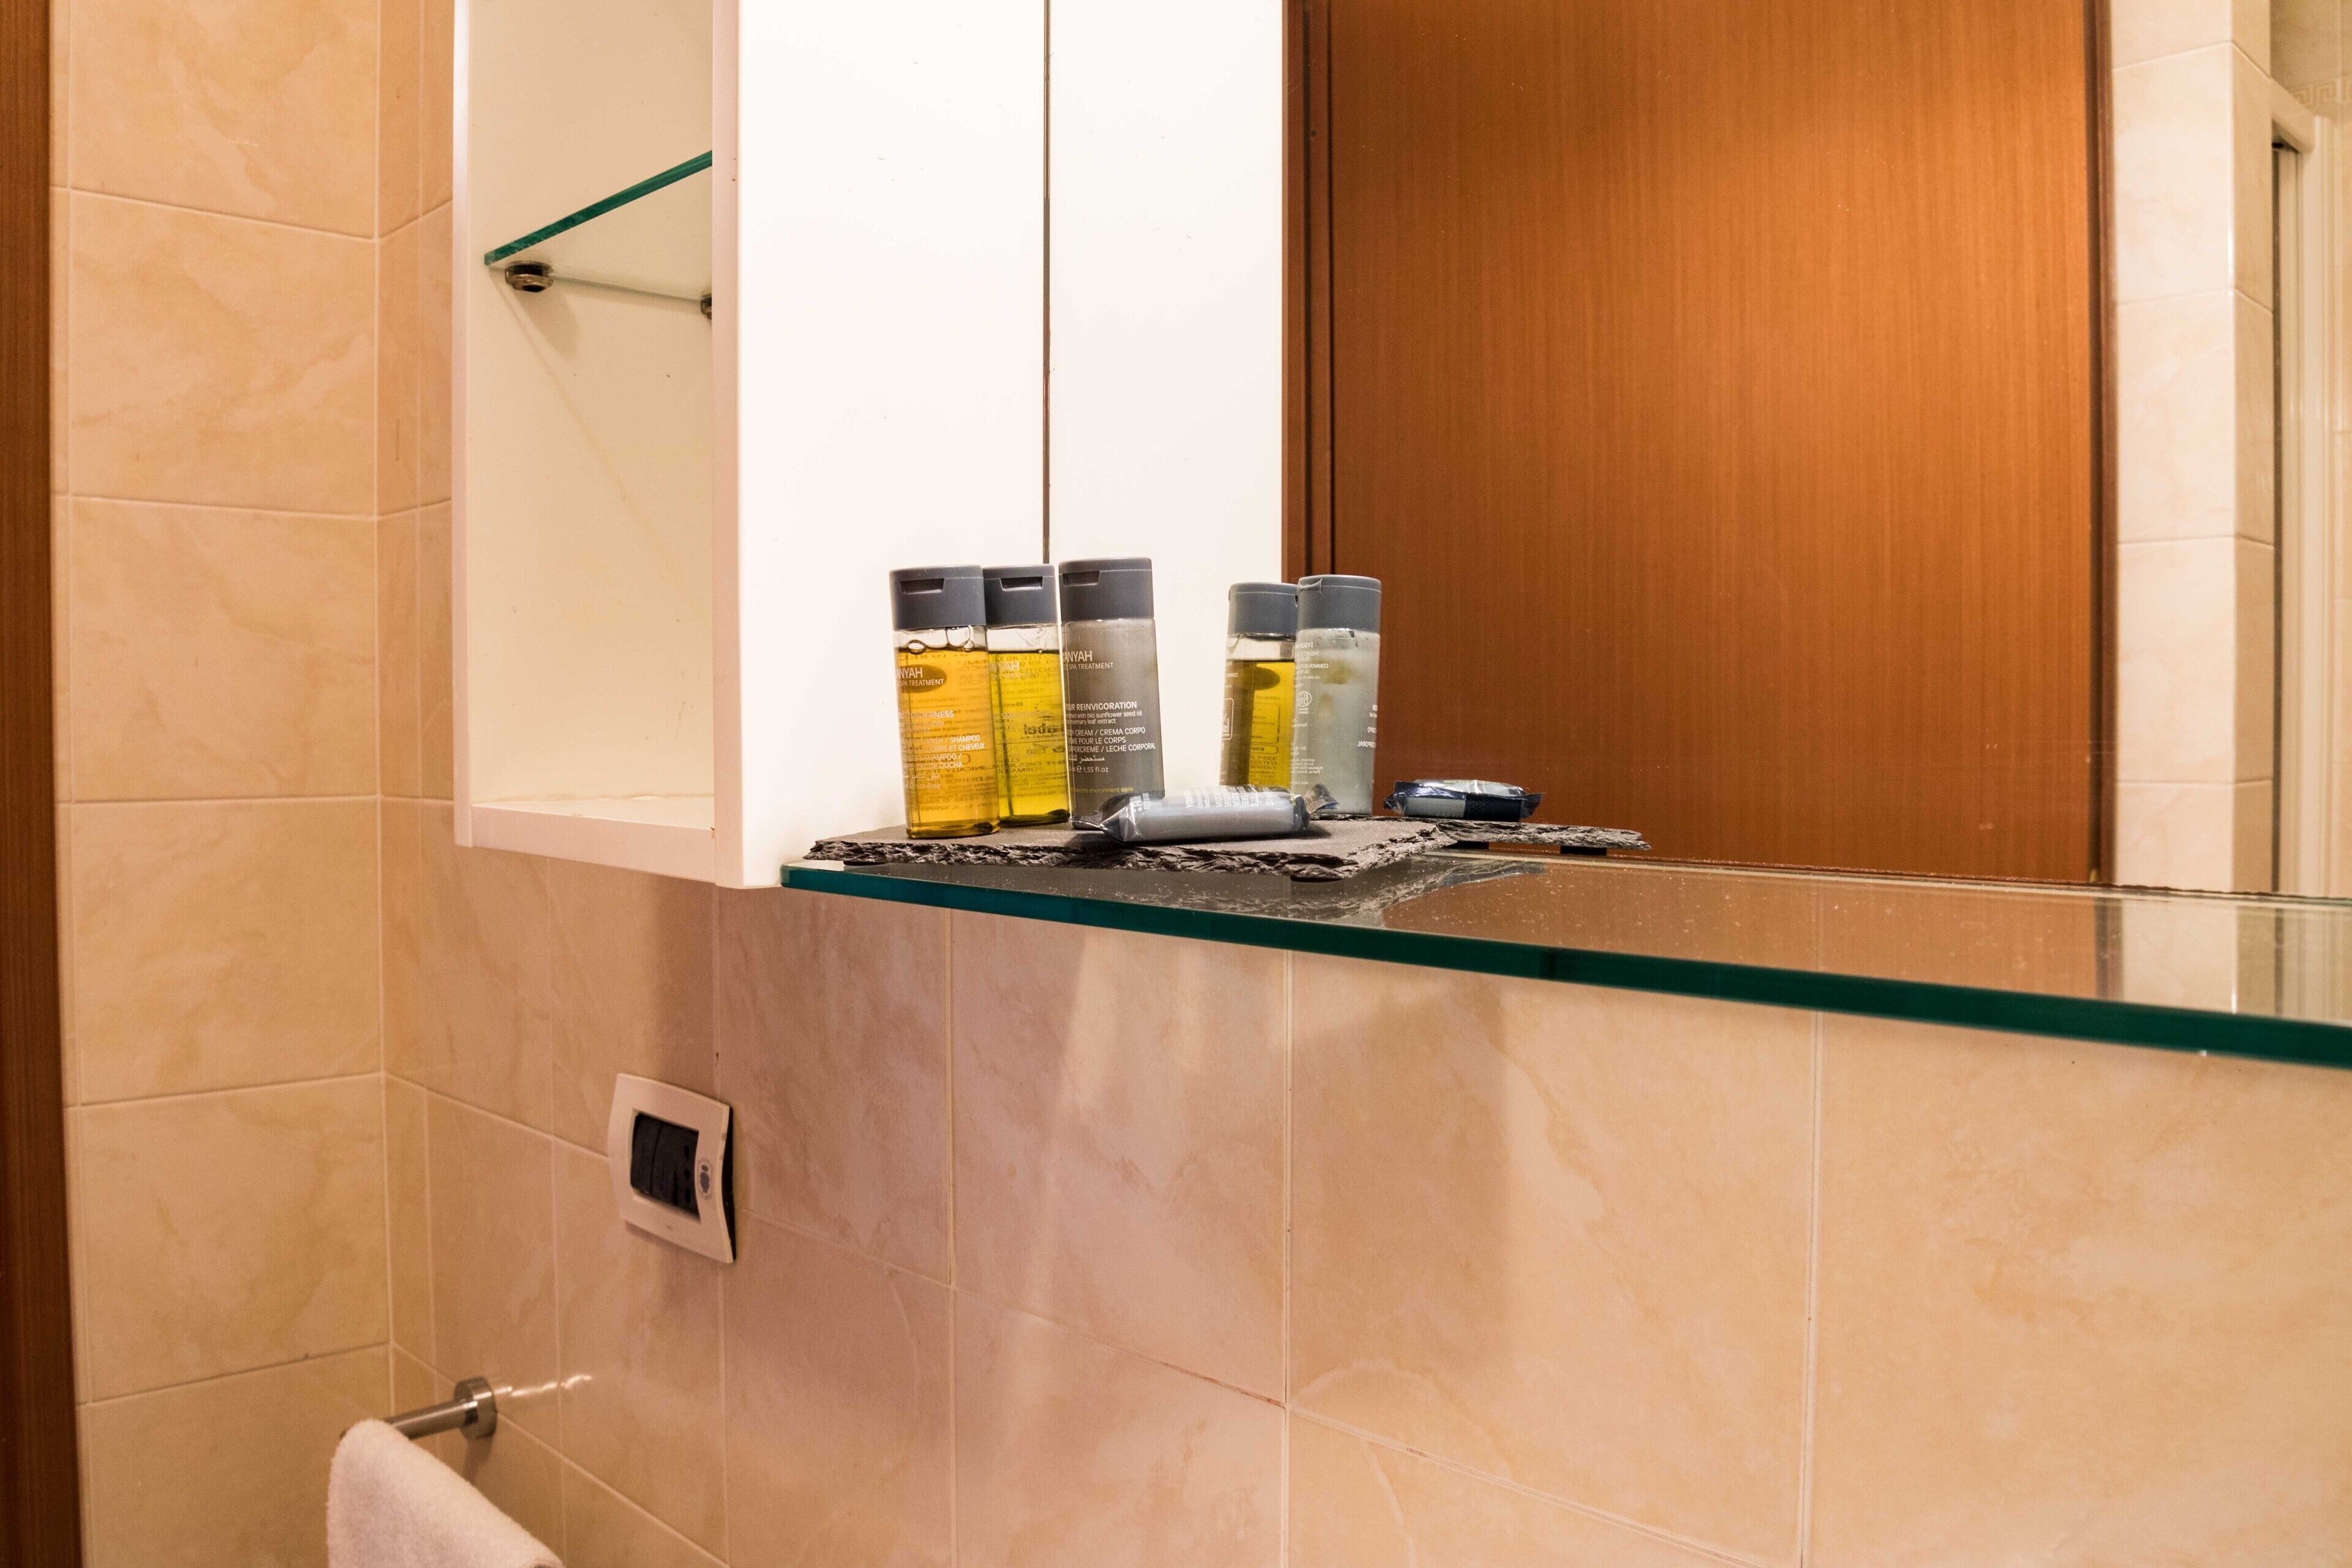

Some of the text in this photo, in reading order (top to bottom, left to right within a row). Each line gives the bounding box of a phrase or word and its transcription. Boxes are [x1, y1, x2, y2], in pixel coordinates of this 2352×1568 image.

[1077, 701, 1137, 711] REINVIGORATION
[1099, 728, 1124, 736] CREMA
[950, 734, 980, 743] SHAMPOO
[1106, 744, 1127, 753] LECHE
[1128, 742, 1156, 751] CORPORAL
